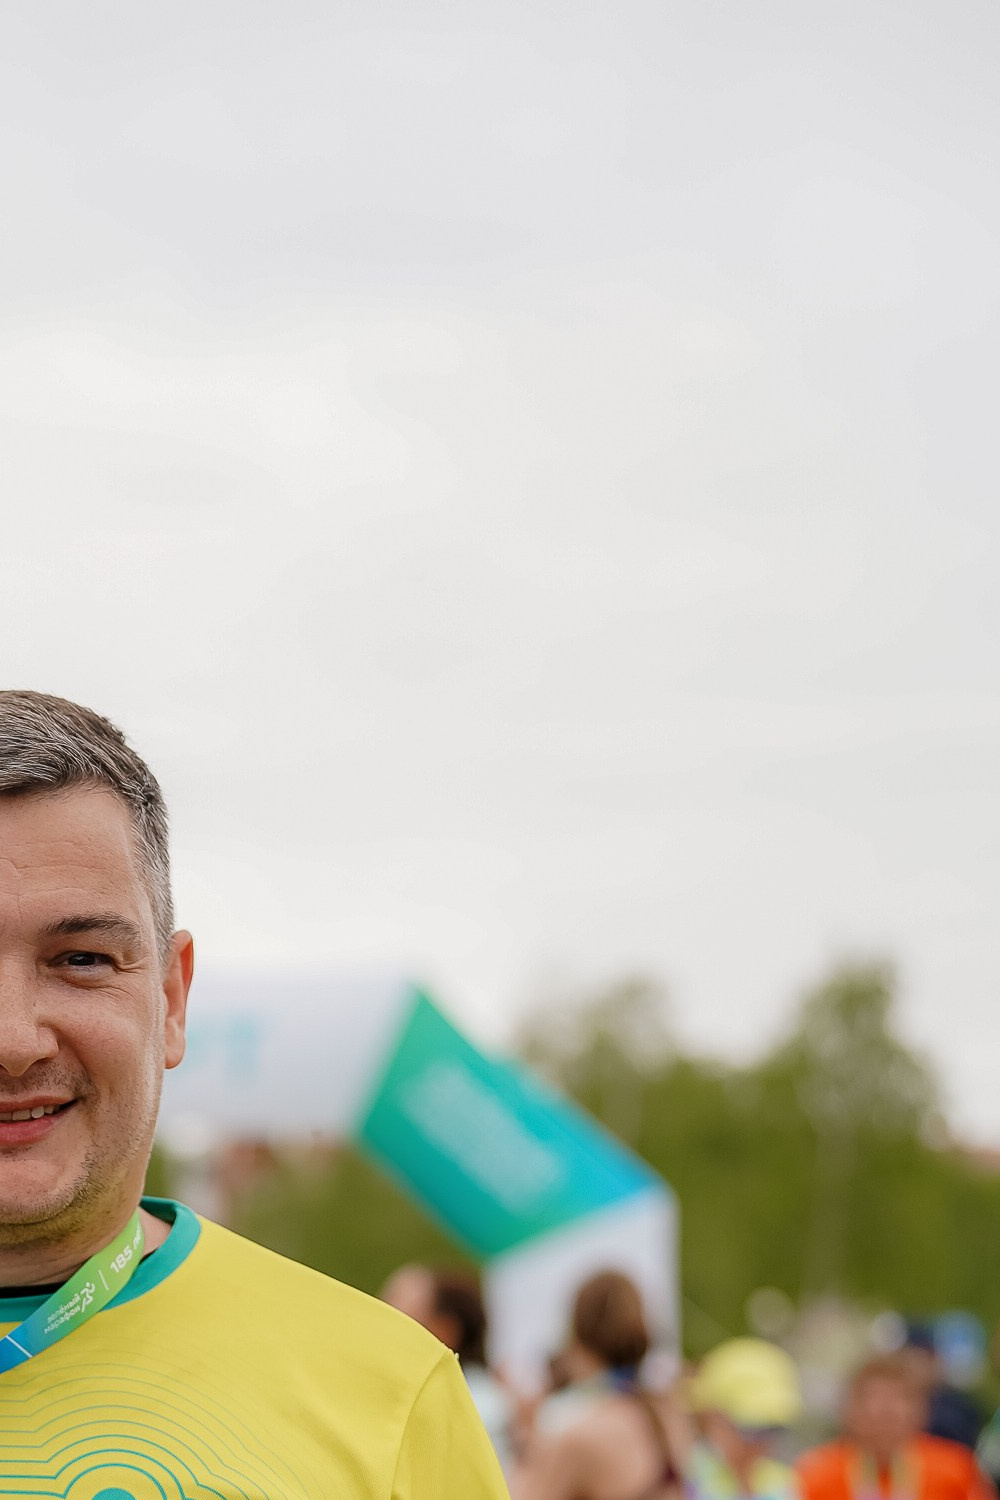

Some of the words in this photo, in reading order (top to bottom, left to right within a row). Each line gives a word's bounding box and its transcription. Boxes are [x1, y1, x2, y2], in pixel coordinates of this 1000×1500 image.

[110, 1246, 133, 1273] 185
[44, 1304, 82, 1334] марафон
[47, 1293, 81, 1324] зелёный
